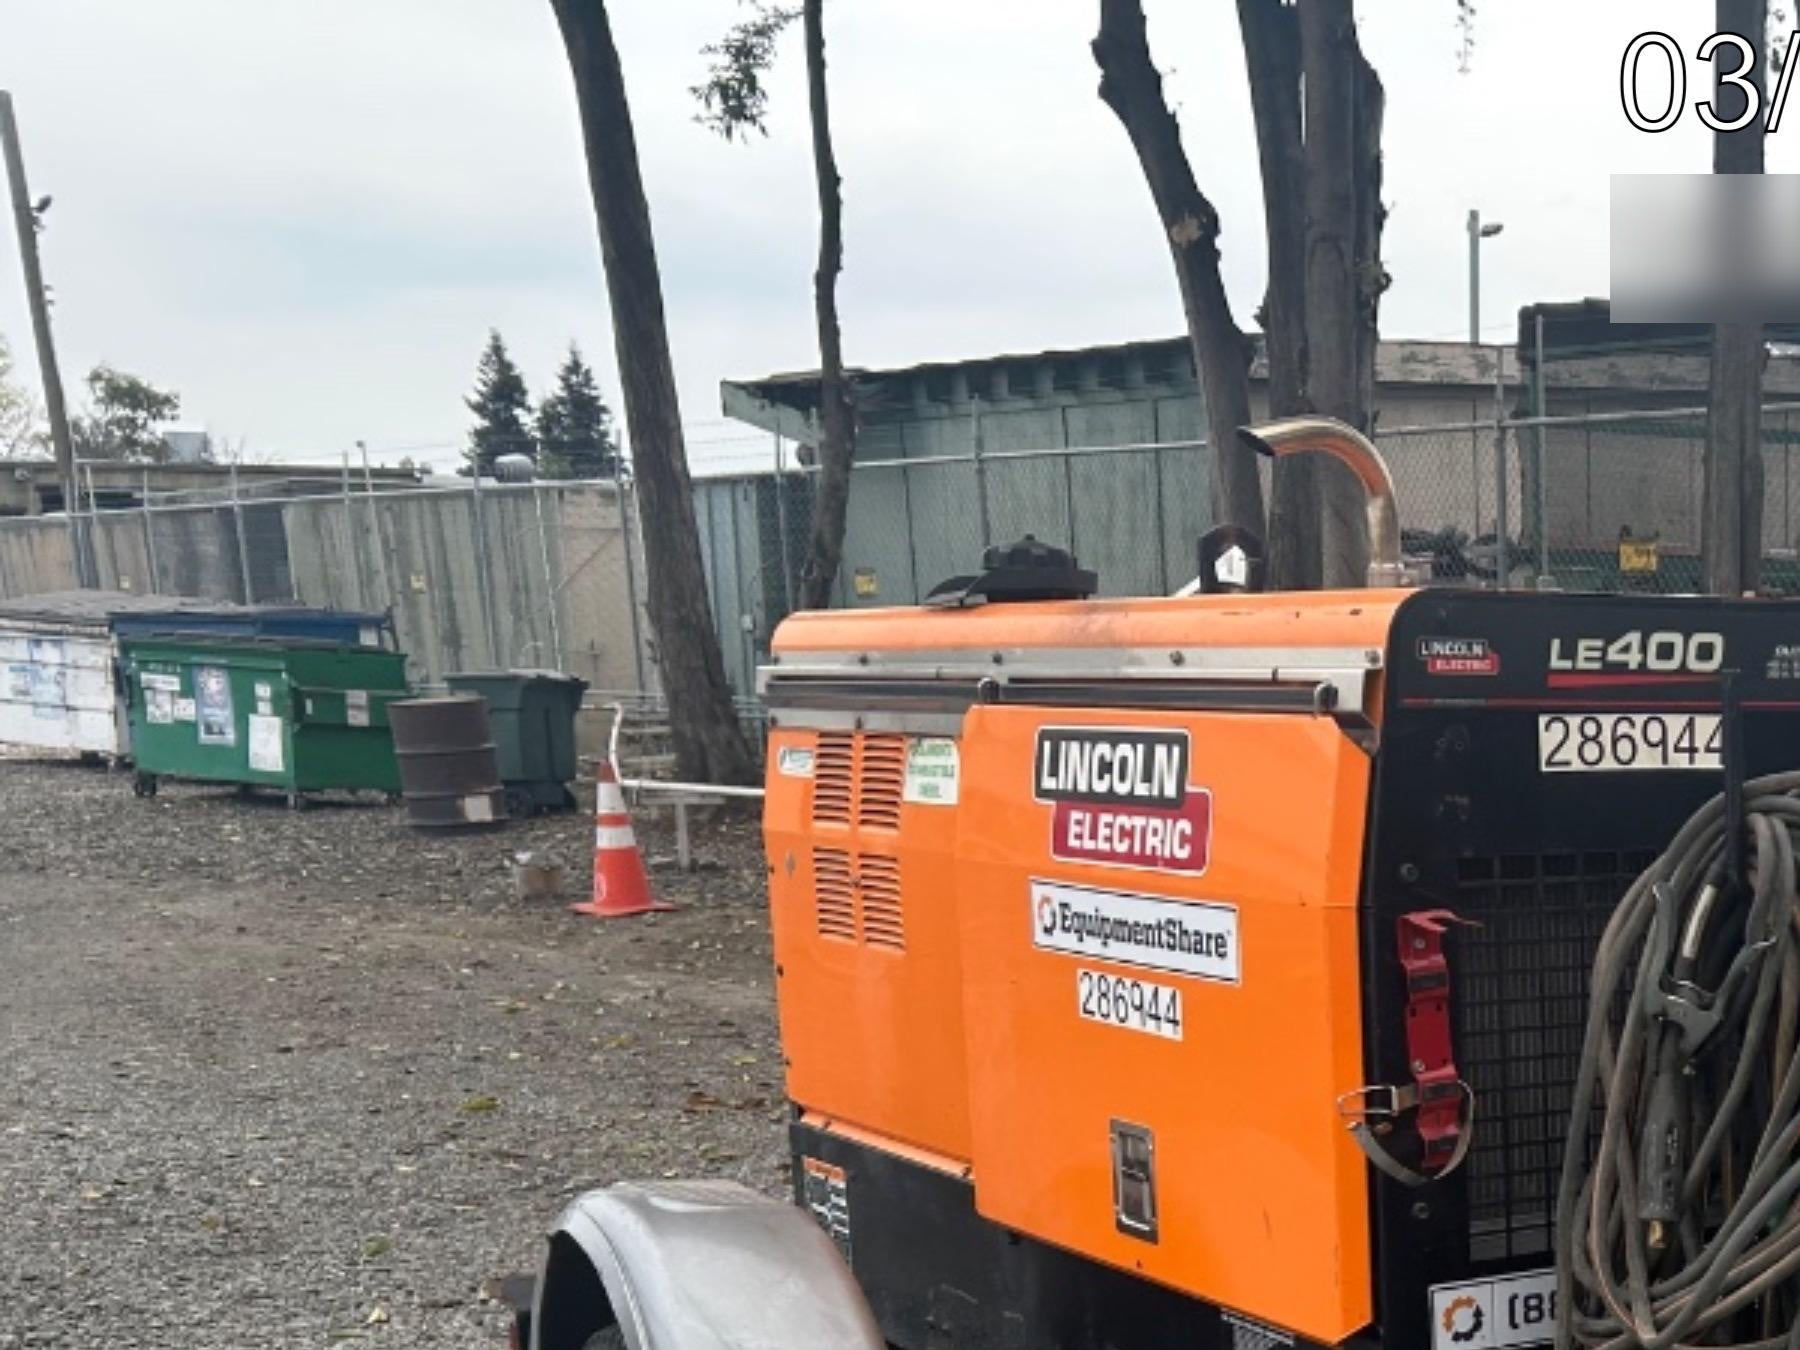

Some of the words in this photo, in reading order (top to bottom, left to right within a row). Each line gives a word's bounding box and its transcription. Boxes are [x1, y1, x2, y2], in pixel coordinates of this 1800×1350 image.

[1420, 640, 1484, 658] LINCOLN
[1435, 659, 1492, 671] ELECTRIC
[1549, 629, 1724, 672] LE400
[1040, 739, 1181, 799] LINCOLN
[1066, 810, 1192, 860] ELECTRIC
[1058, 902, 1228, 960] EquipmentShare
[1079, 971, 1181, 1035] 286944
